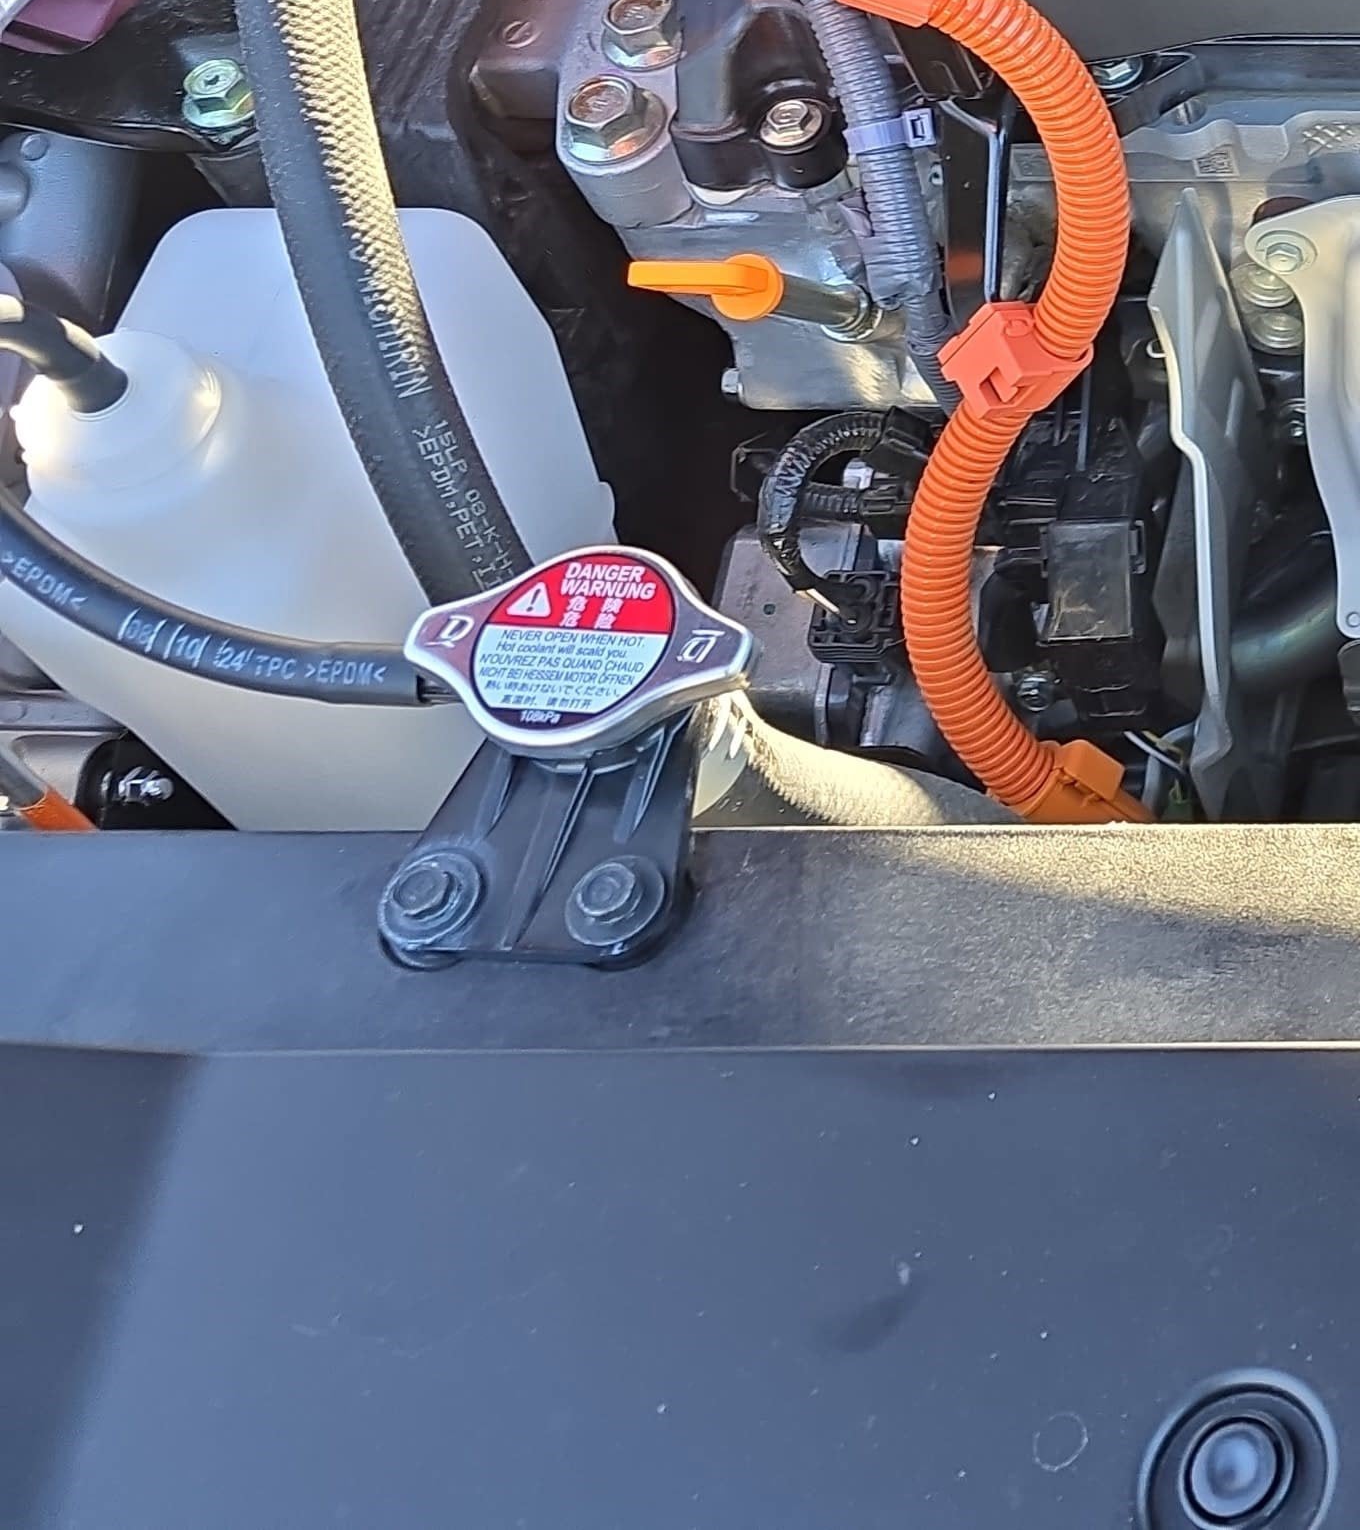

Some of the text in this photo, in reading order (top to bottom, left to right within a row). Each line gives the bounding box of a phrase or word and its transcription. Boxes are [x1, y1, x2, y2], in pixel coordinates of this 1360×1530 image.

[565, 562, 646, 583] DANGER
[560, 579, 657, 600] WARNUNG
[501, 629, 543, 642] NEVER
[544, 630, 577, 644] OPEN
[580, 631, 617, 645] WHEN
[496, 641, 516, 652] Hot
[517, 642, 556, 654] coolant
[558, 643, 575, 655] will
[576, 644, 606, 657] scald
[537, 654, 561, 668] PAS
[562, 656, 604, 670] QUAND
[605, 659, 645, 673] CHAUD
[564, 670, 598, 683] MOTOR
